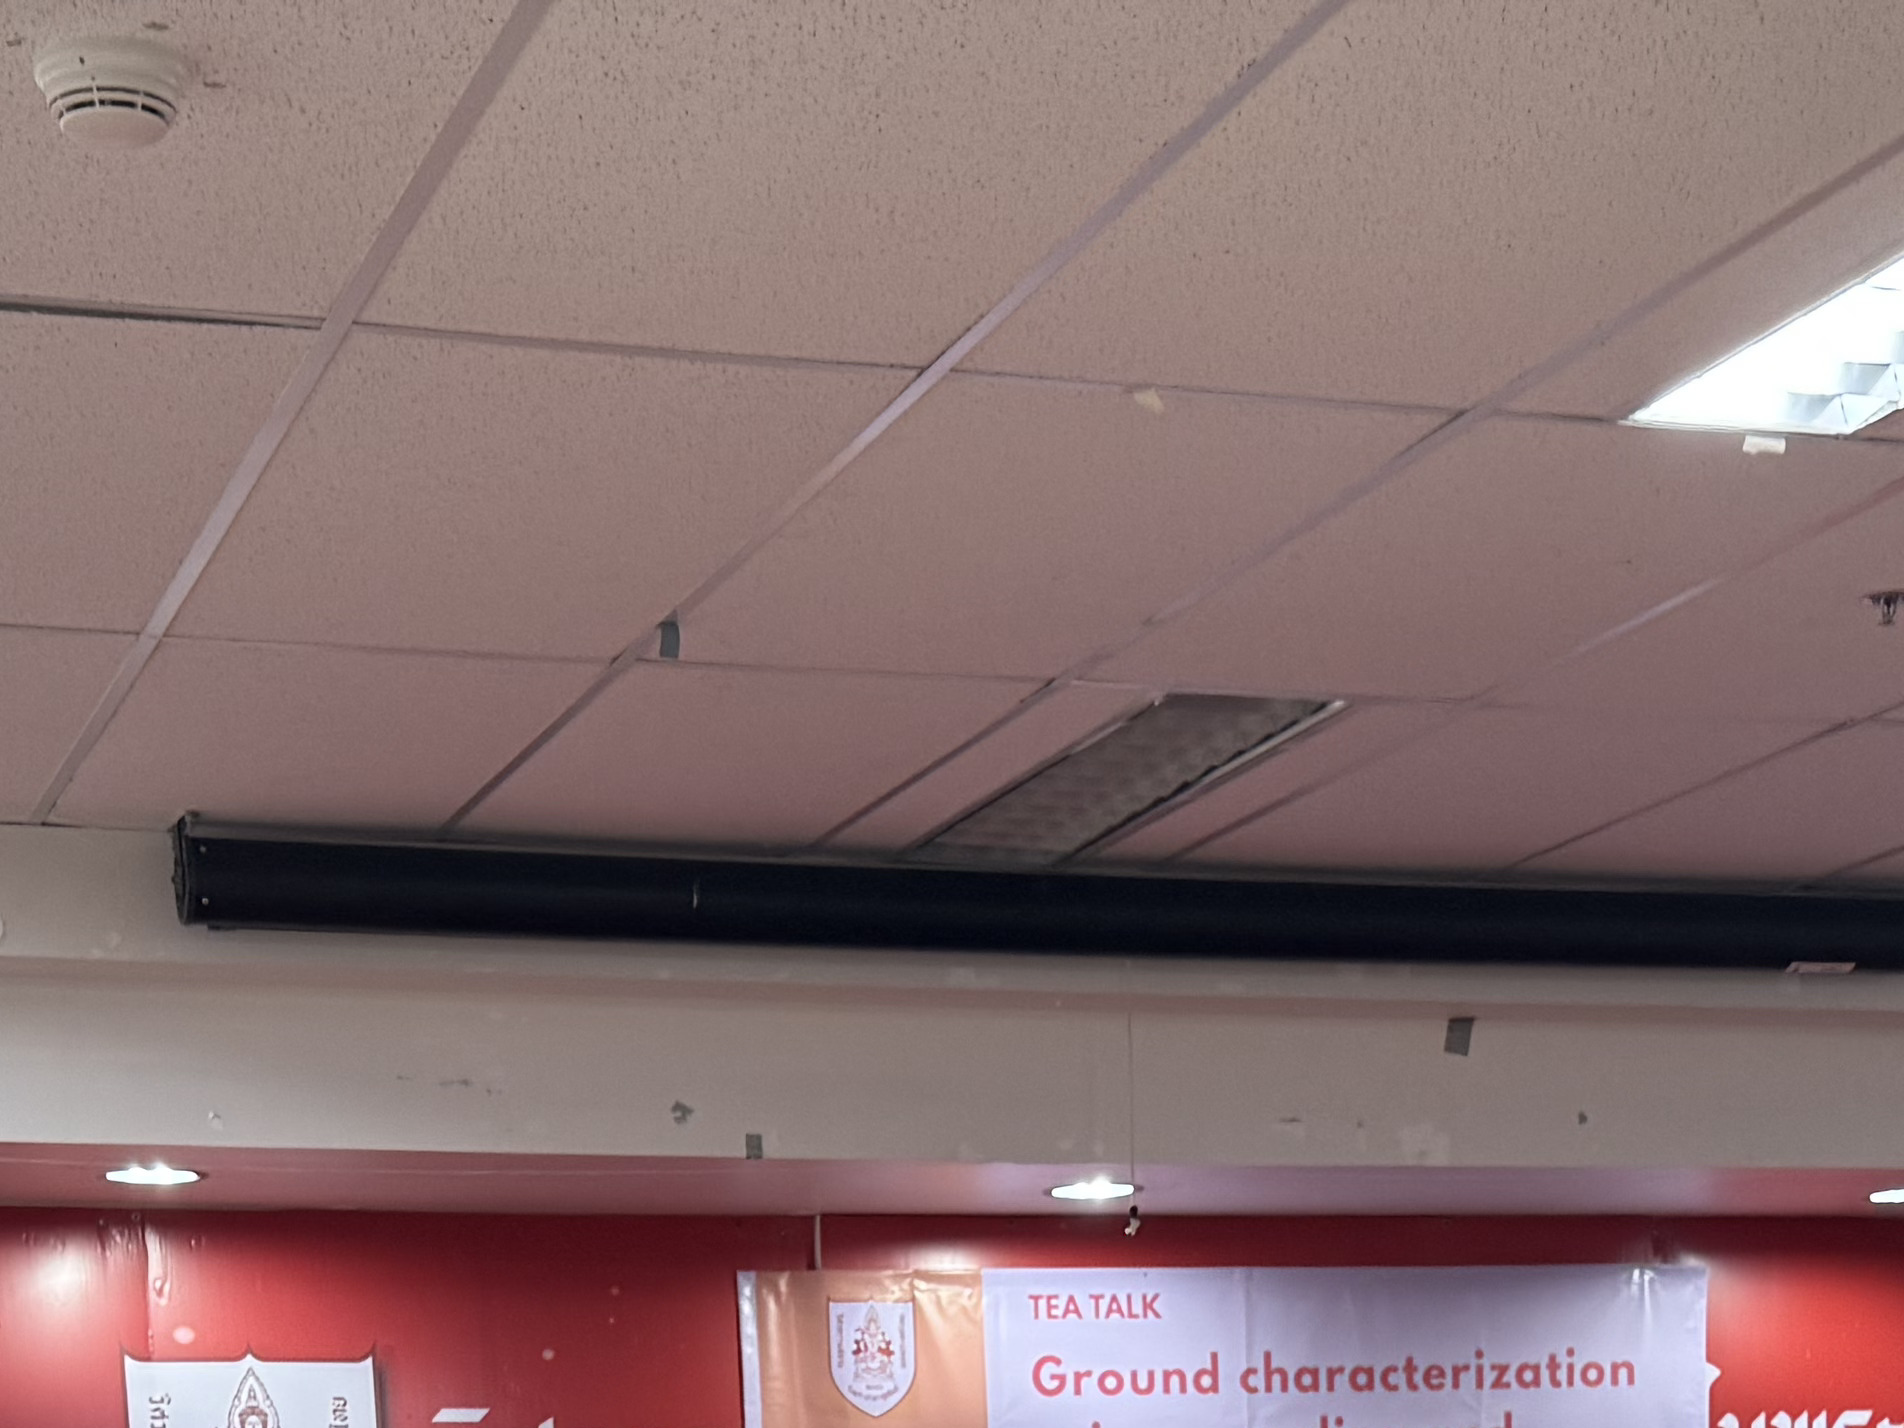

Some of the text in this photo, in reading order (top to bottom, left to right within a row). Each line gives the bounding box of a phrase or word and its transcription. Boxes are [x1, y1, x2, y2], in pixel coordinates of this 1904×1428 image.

[1028, 1292, 1162, 1322] TEA TALK
[1031, 1347, 1637, 1400] Ground characterization
